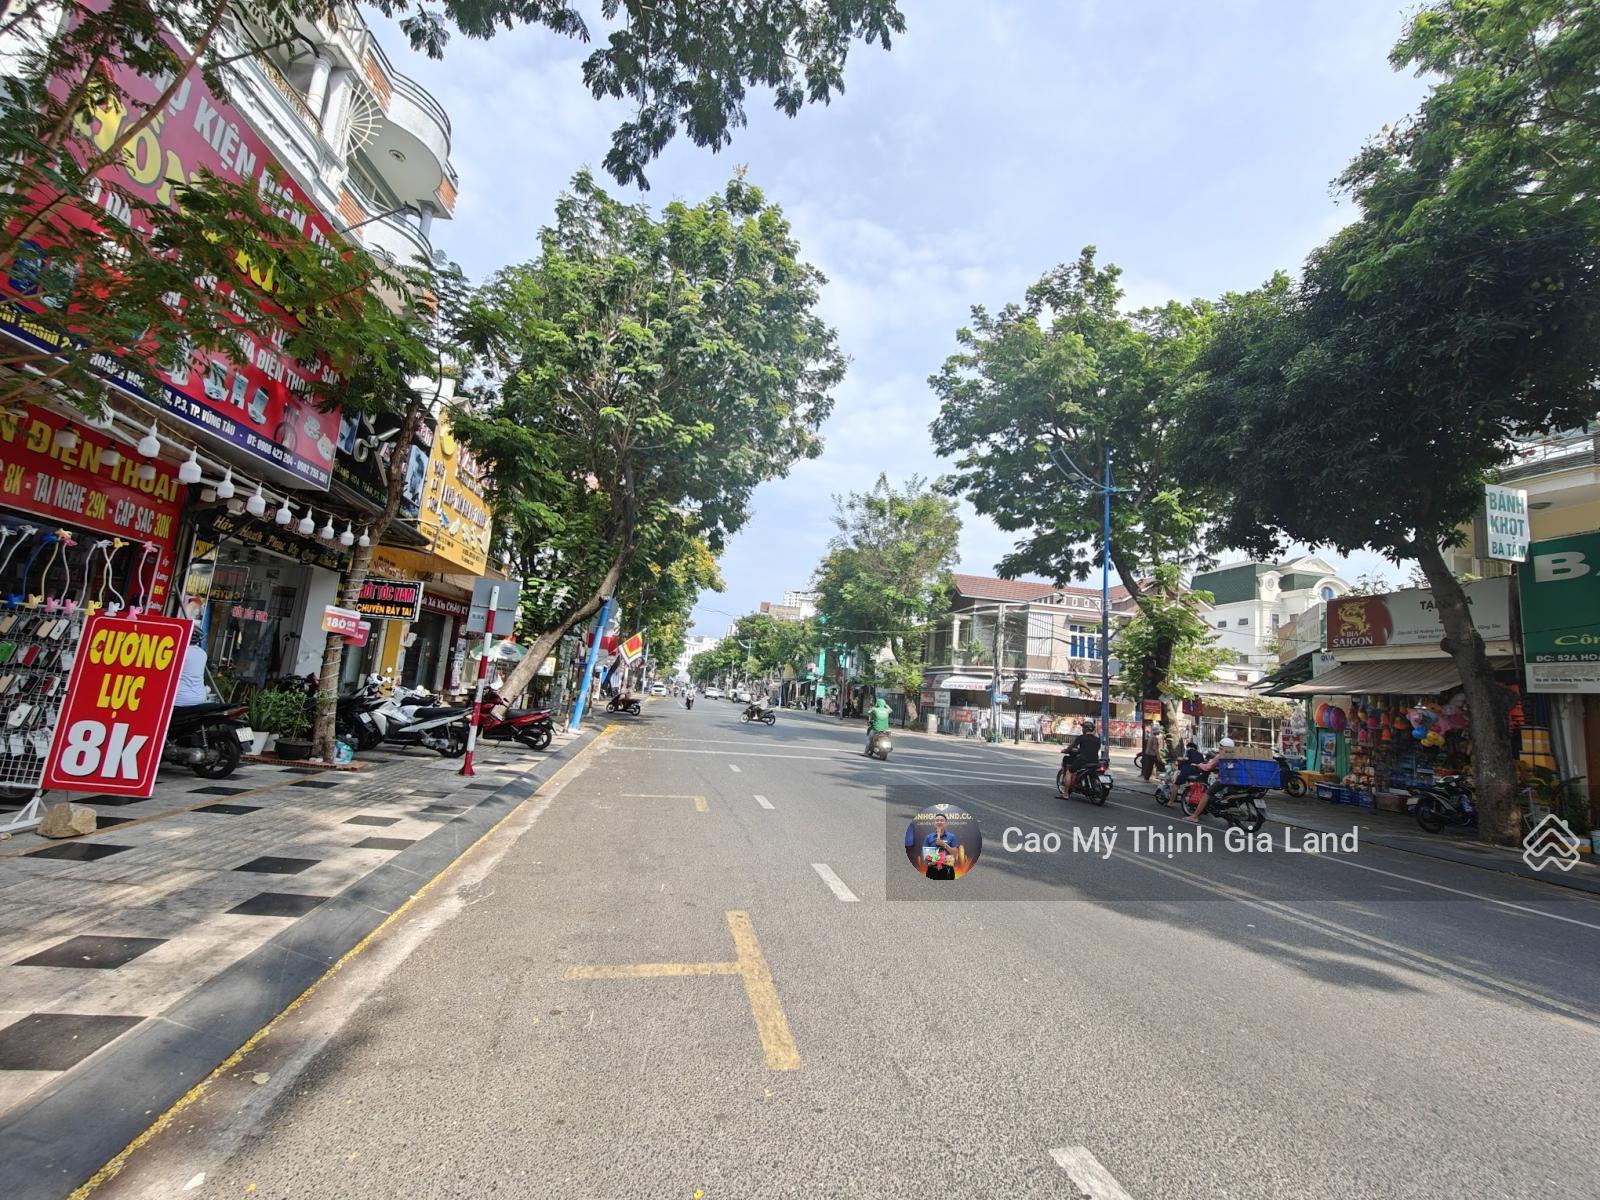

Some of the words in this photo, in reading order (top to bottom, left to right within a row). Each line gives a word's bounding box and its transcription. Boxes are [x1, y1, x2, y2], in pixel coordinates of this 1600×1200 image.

[193, 96, 257, 180] KIỆN
[256, 348, 285, 383] ĐIỆN
[222, 420, 236, 437] TÀU
[4, 463, 25, 495] 8K
[34, 472, 55, 504] TAI
[53, 478, 88, 514] NGHE
[85, 490, 109, 521] 29K
[113, 496, 135, 528] CÁP
[135, 504, 155, 537] SẠC
[154, 513, 173, 539] 30K
[1488, 490, 1525, 514] BÁNH
[1490, 515, 1525, 540] KHỌT
[377, 583, 394, 601] TÓC
[394, 586, 416, 604] NAM
[356, 602, 385, 615] CHUYÊN
[401, 606, 412, 617] TAI
[327, 616, 347, 629] 180
[89, 624, 175, 671] CƯỜNG
[1332, 636, 1374, 648] SAIGON
[96, 673, 146, 719] LỰC
[60, 720, 149, 780] 8k
